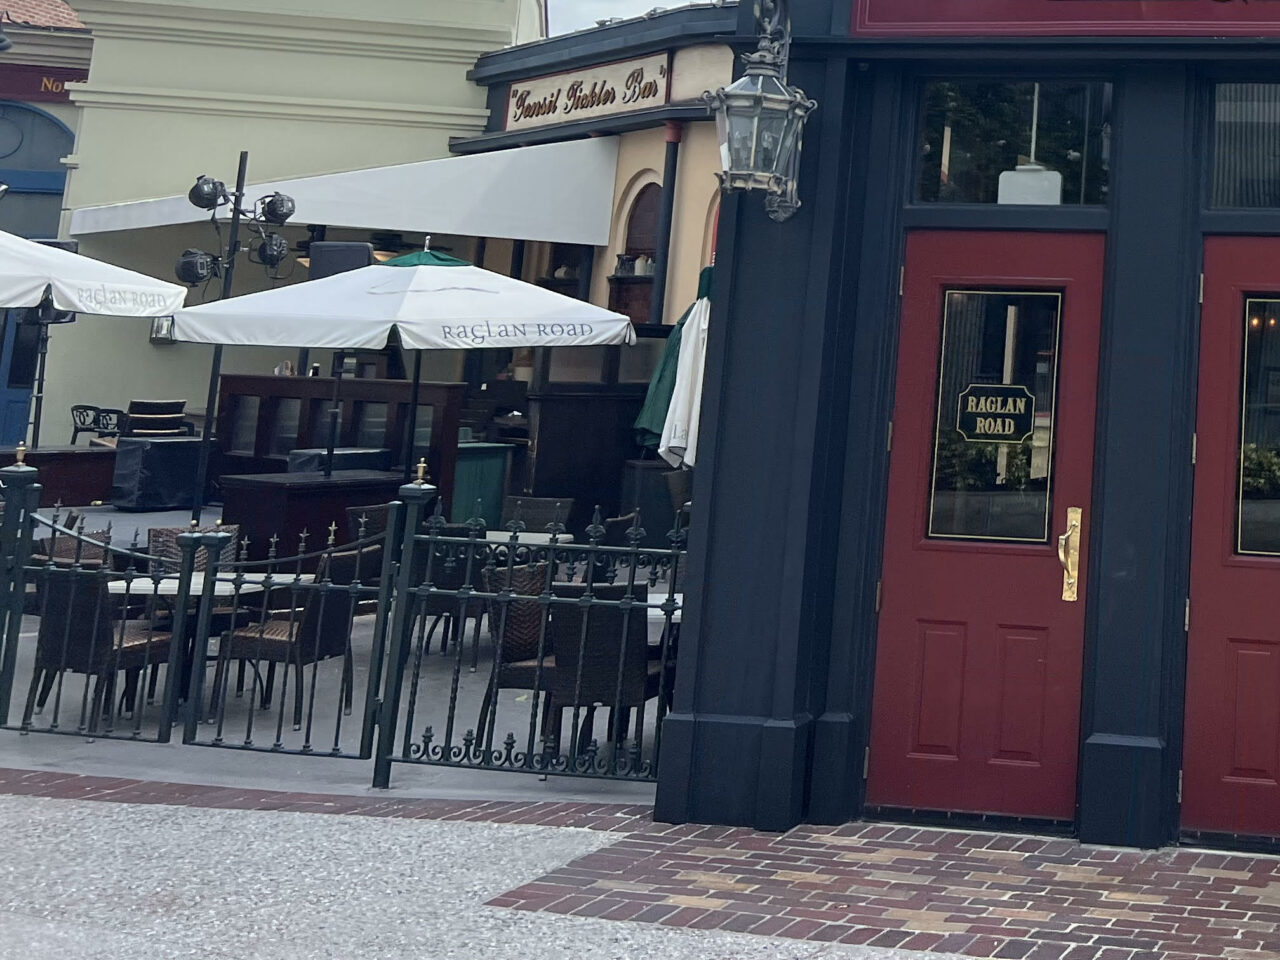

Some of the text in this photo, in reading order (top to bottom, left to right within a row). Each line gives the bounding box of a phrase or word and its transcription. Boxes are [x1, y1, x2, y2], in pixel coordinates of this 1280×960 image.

[563, 80, 616, 114] Tickler
[966, 396, 1027, 414] RAGLAN
[975, 417, 1015, 435] ROAD
